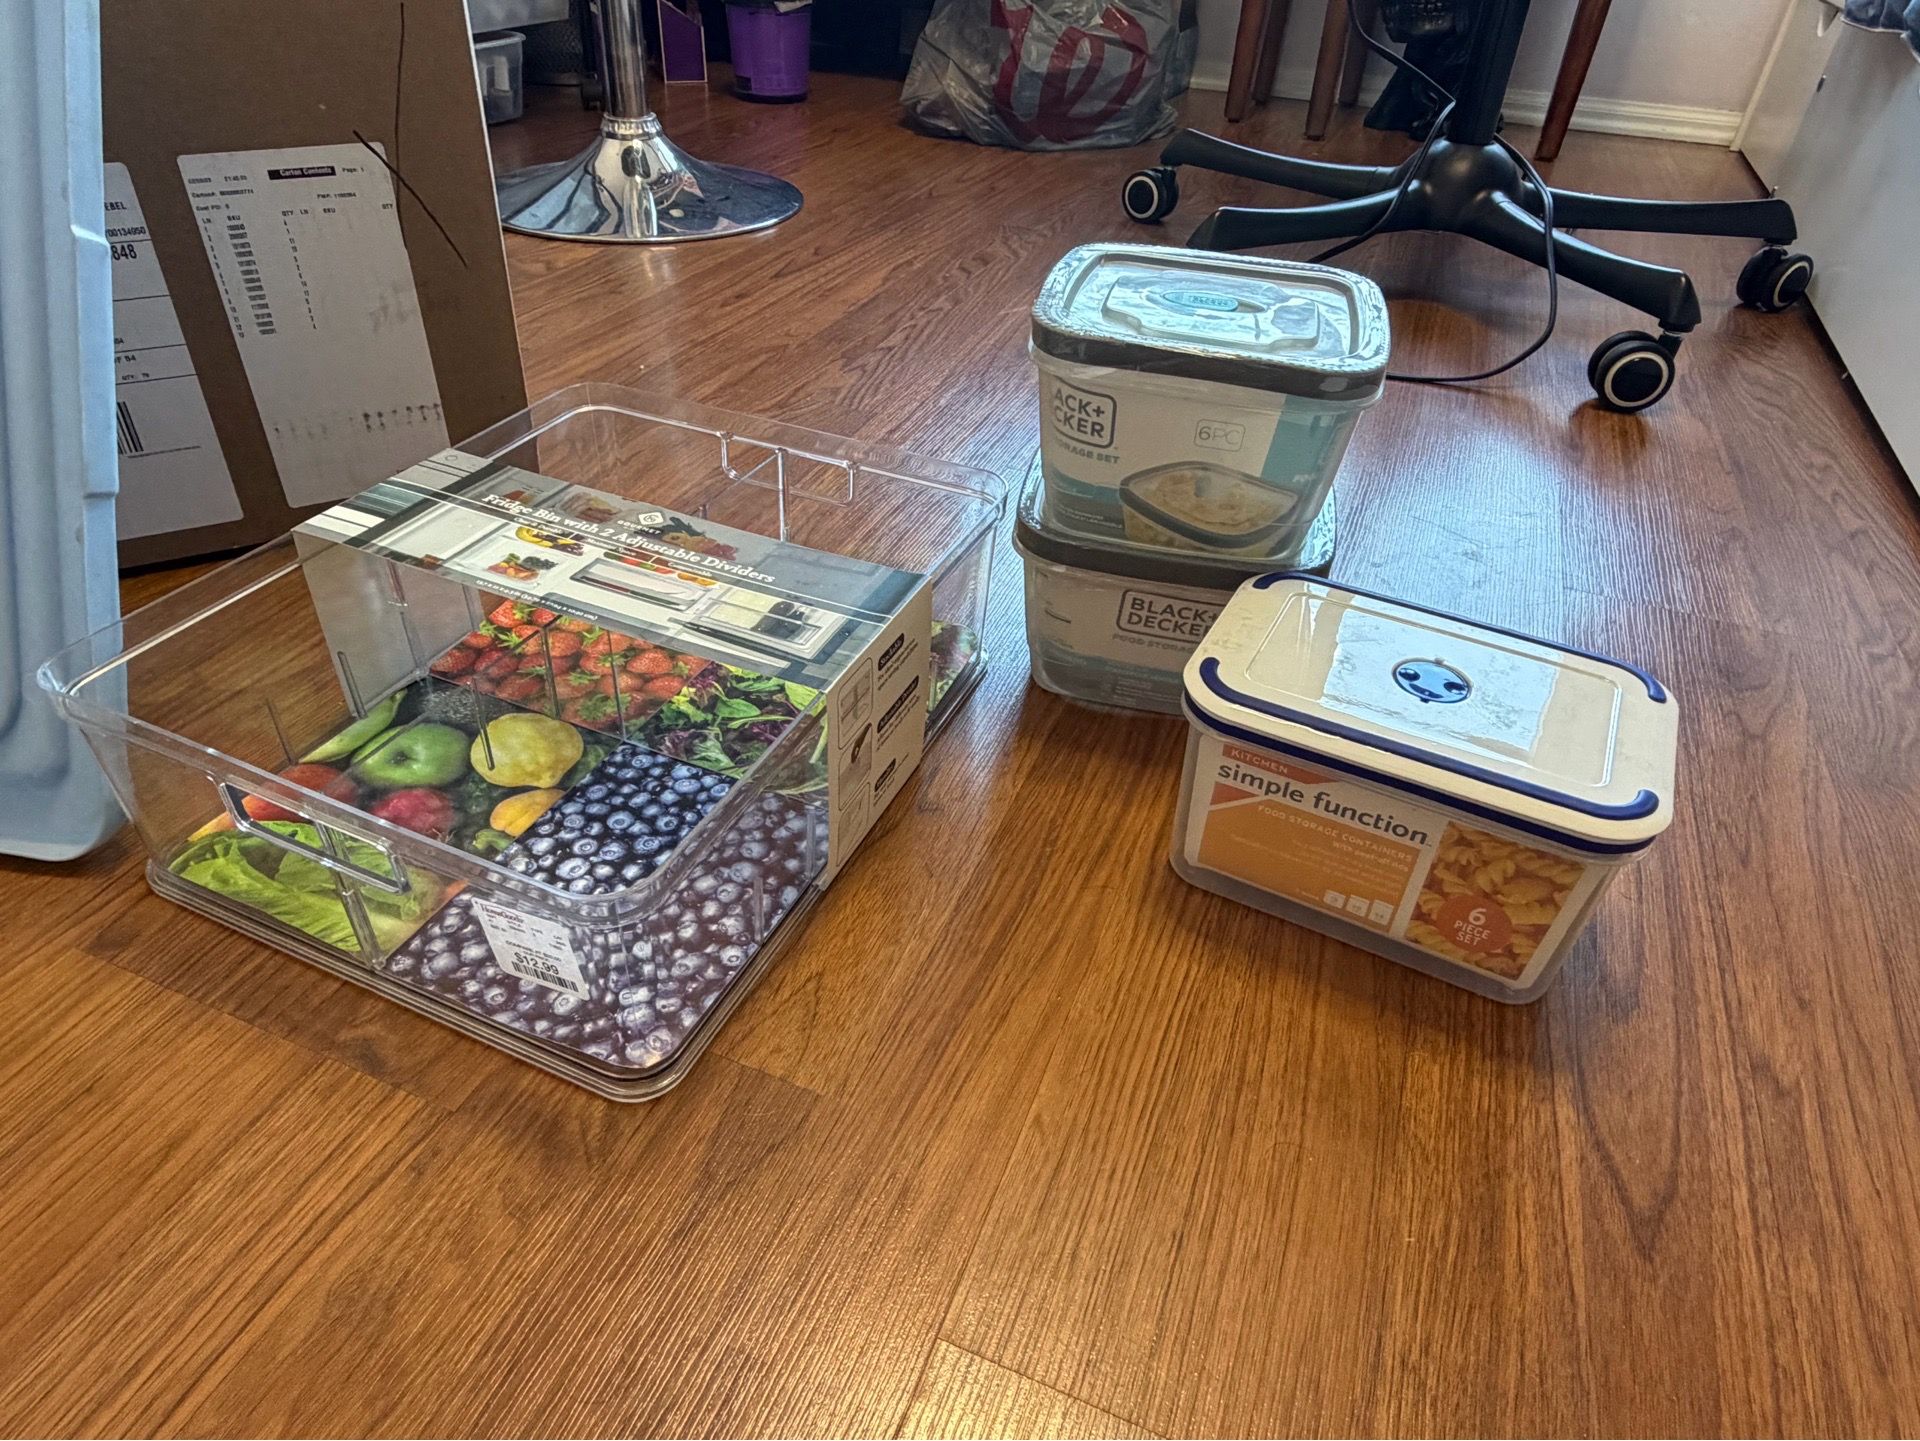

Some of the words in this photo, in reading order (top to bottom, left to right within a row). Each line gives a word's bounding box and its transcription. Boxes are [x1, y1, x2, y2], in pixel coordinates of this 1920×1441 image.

[110, 244, 137, 261] 848
[1198, 425, 1241, 446] 6PC
[482, 494, 531, 518] Fridge
[533, 507, 560, 524] Bin
[563, 516, 598, 537] with
[601, 526, 615, 537] 2
[613, 532, 700, 563] Adjustable
[701, 556, 776, 584] Dividers
[1130, 597, 1217, 623] BLACK+
[1218, 763, 1304, 803] simple
[1313, 791, 1429, 845] function
[1258, 805, 1286, 820] FOOD
[1289, 815, 1340, 838] STORAGE
[1342, 833, 1412, 862] CONTAINERS
[1469, 908, 1487, 926] 6
[1454, 920, 1491, 940] PIECE
[1456, 931, 1481, 946] SET
[514, 952, 560, 975] $12.99
